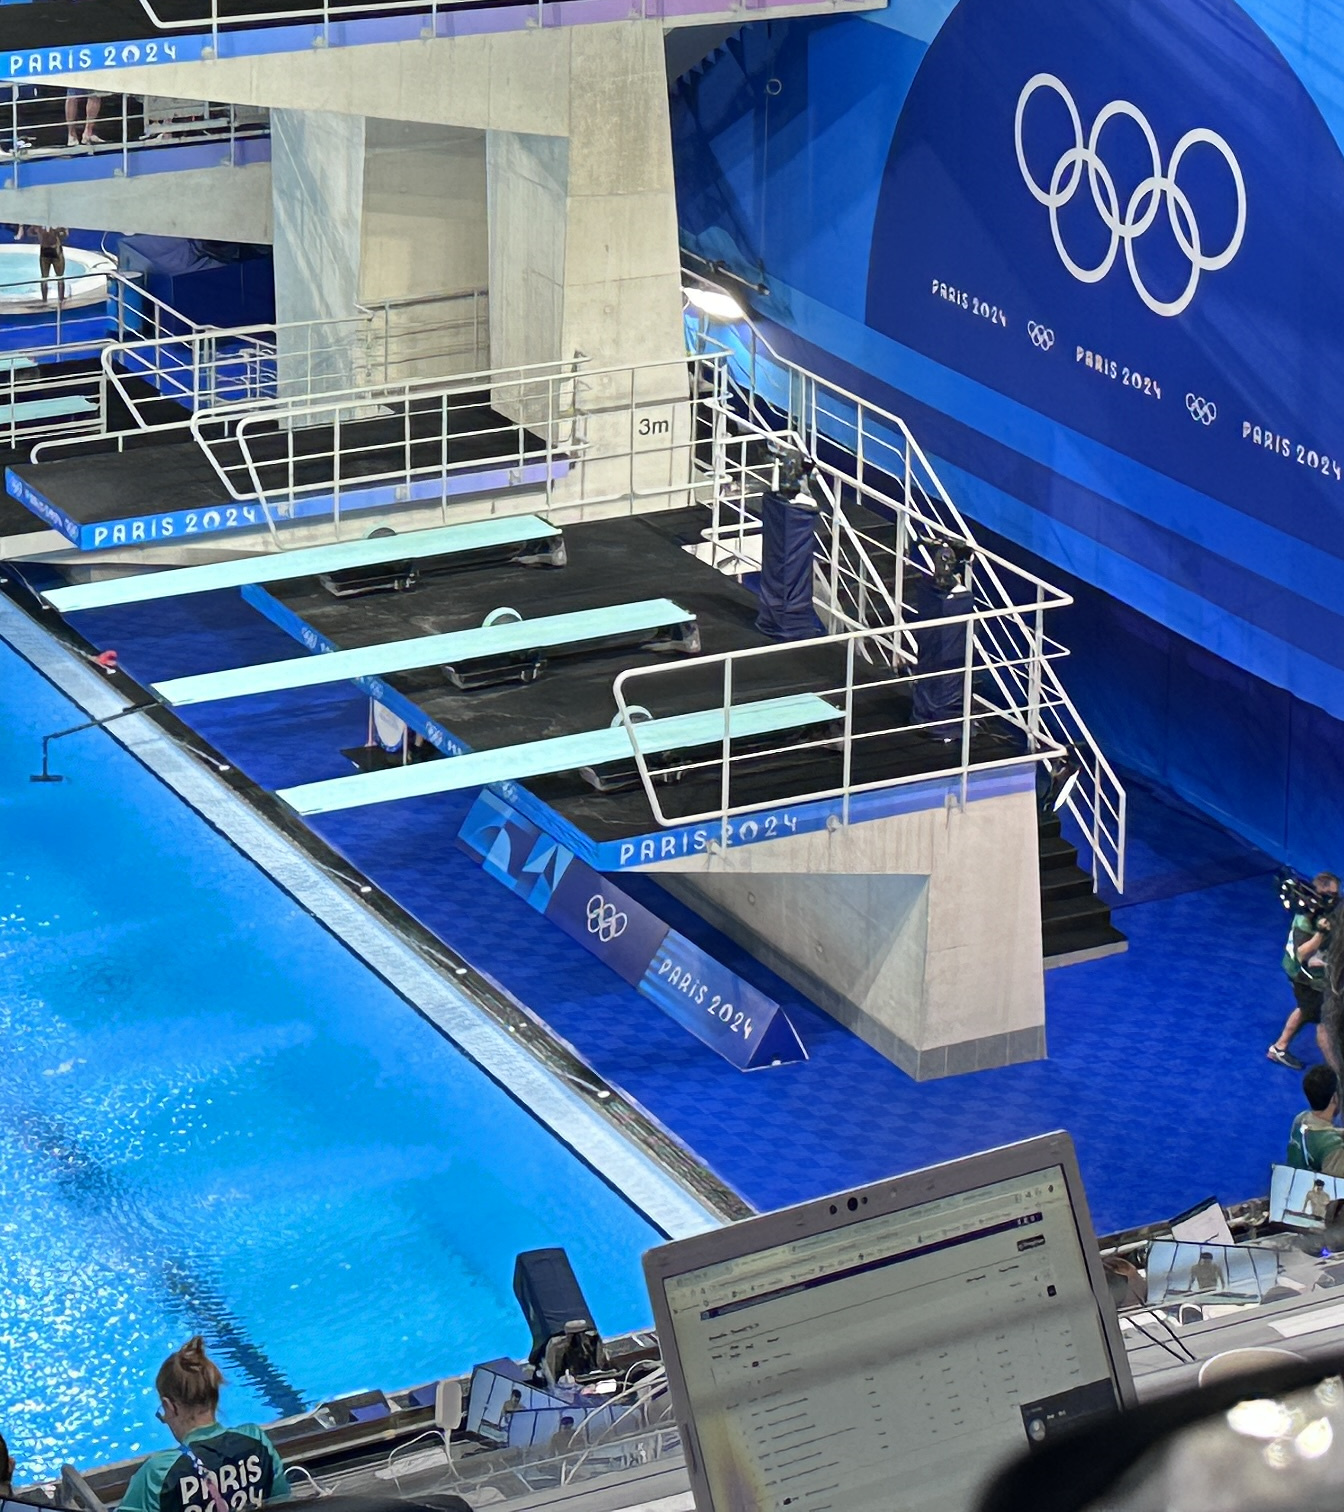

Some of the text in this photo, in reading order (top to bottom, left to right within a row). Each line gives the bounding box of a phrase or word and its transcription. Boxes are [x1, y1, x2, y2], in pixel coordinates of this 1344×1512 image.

[10, 42, 176, 75] PARIS 2024
[932, 279, 1006, 327] PARIS 2024
[1076, 345, 1161, 400] PARIS 2024
[638, 418, 669, 435] 3m
[1243, 421, 1341, 481] PARIS 2024
[94, 506, 256, 546] PARIS 2024
[620, 830, 708, 865] PARIS
[658, 958, 753, 1040] PARIS 2024
[179, 1455, 262, 1505] PARIS
